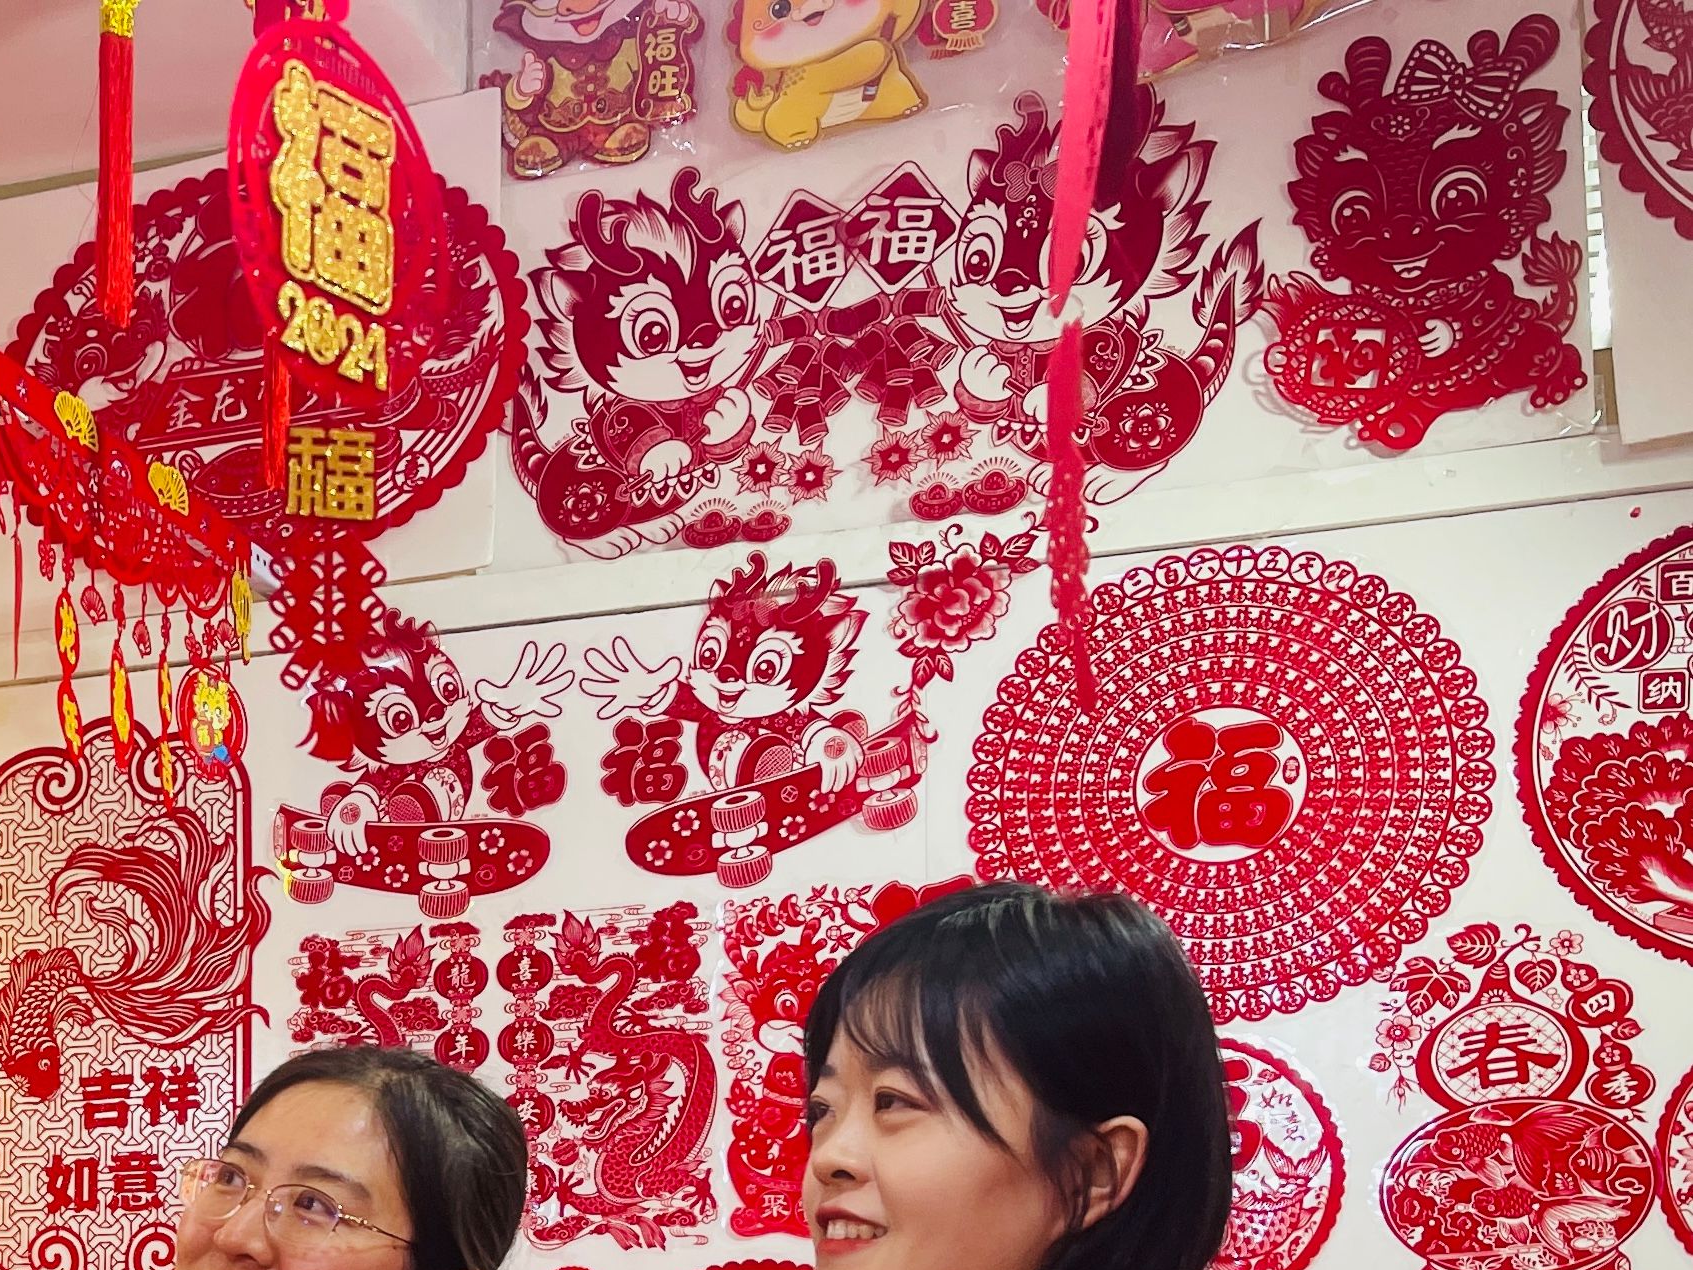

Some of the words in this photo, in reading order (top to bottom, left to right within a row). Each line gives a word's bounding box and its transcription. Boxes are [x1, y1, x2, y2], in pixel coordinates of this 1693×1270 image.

[948, 1, 976, 33] 喜
[644, 31, 680, 97] 福旺
[271, 57, 397, 316] 福
[764, 218, 849, 291] 福
[859, 196, 943, 267] 福
[276, 280, 387, 391] 2024
[286, 427, 376, 521] 福
[483, 721, 569, 817] 福
[600, 716, 688, 807] 福
[1141, 716, 1294, 849] 福
[79, 1064, 201, 1130] 吉祥
[1448, 1022, 1560, 1090] 春
[44, 1152, 164, 1214] 如意
